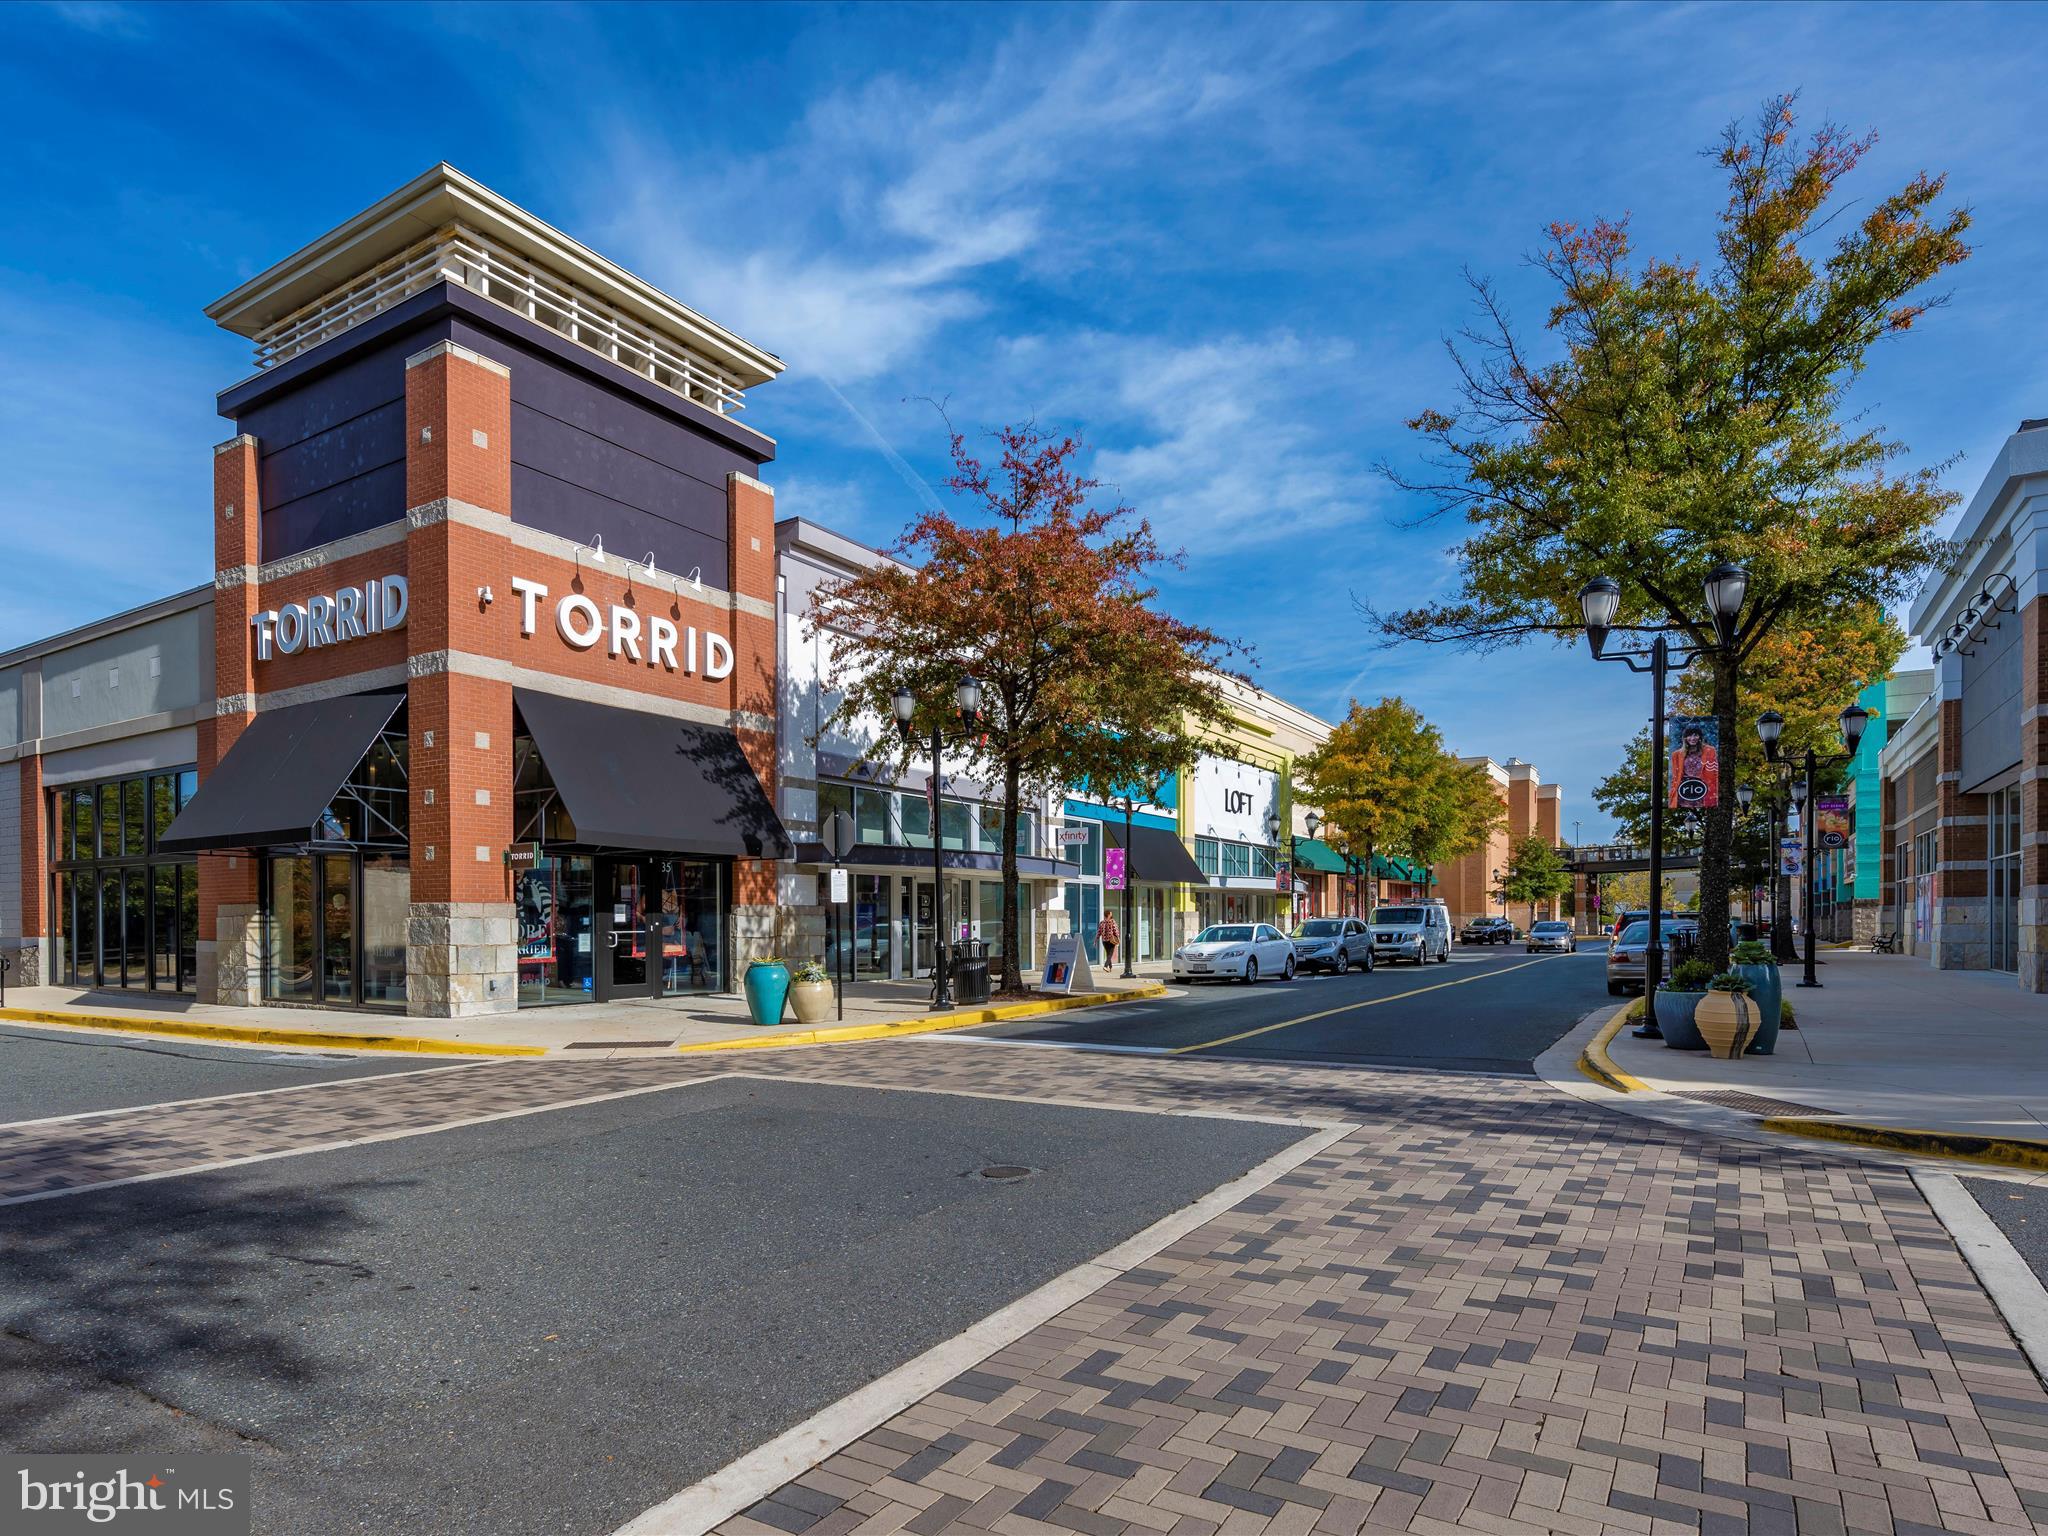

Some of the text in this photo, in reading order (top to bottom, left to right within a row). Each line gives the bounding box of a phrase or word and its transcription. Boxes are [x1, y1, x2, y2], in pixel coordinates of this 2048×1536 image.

[251, 575, 408, 661] TORRID
[511, 576, 734, 680] TORRID
[1682, 786, 1704, 794] rio
[1225, 788, 1254, 816] LOFT
[1059, 830, 1087, 842] xfinity
[510, 852, 534, 860] TORRID
[661, 861, 671, 873] 35
